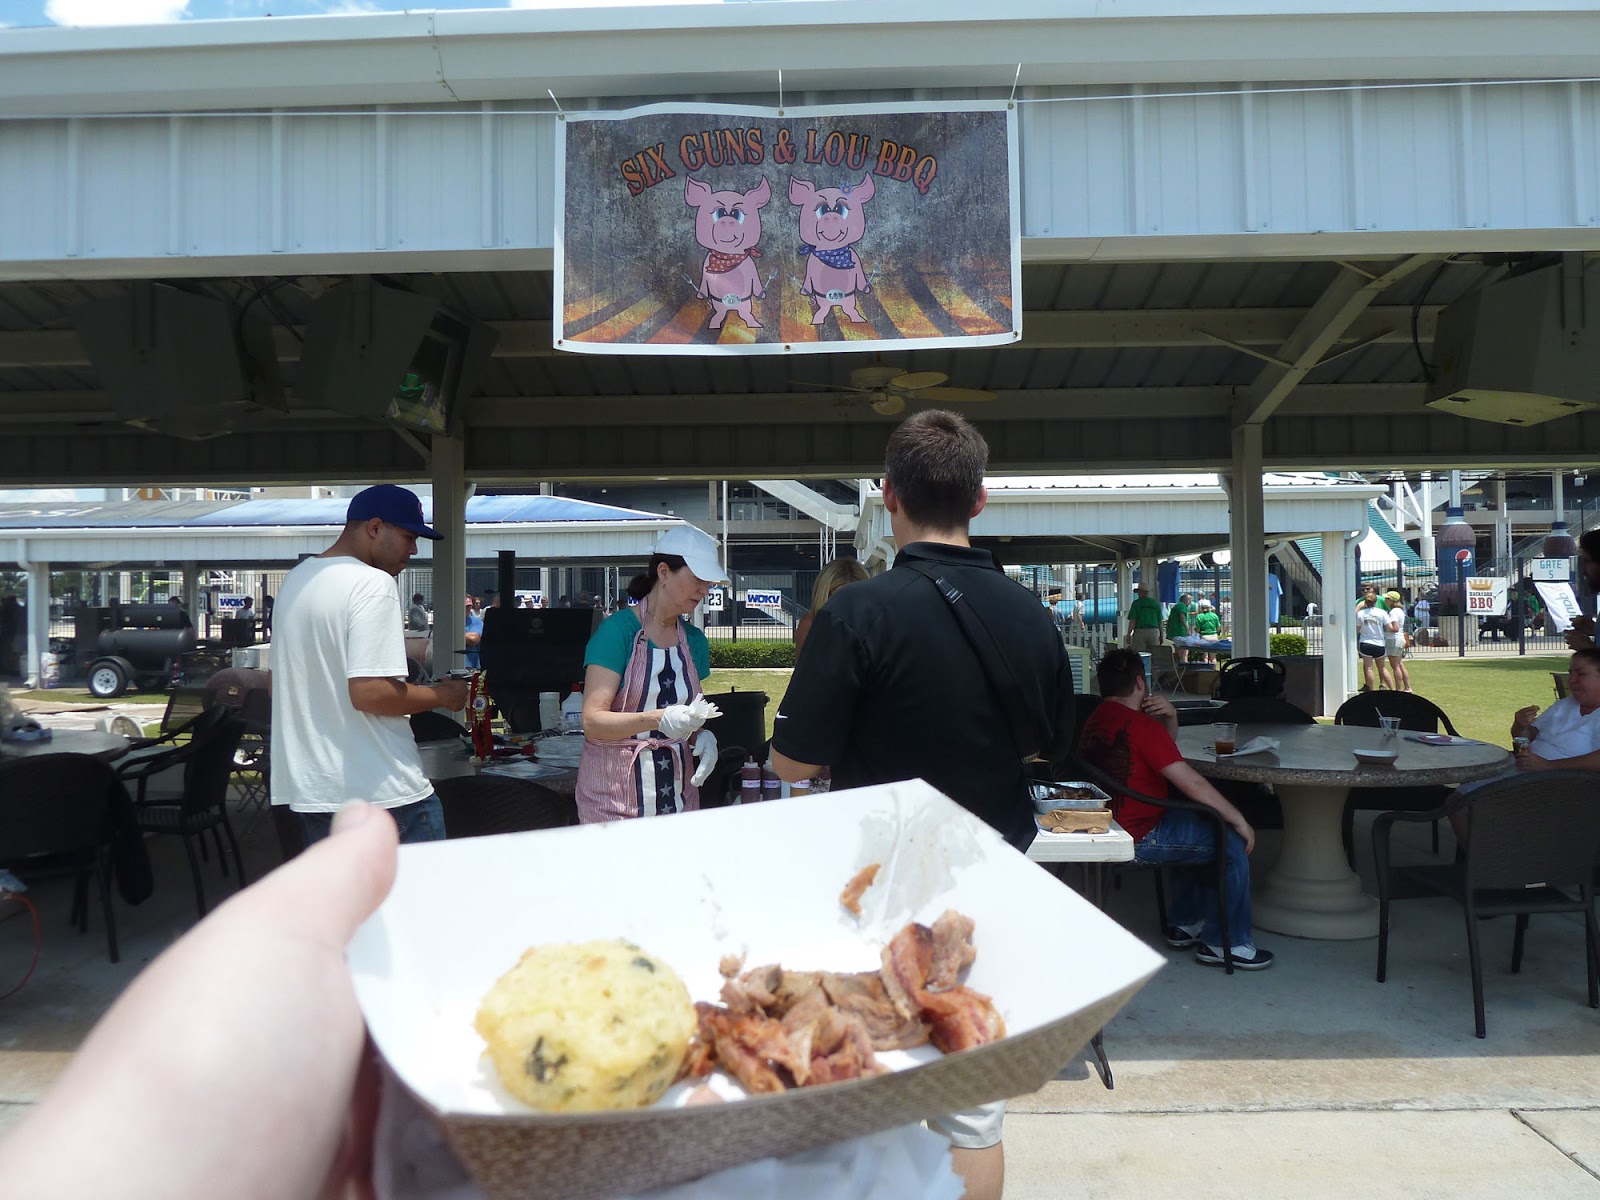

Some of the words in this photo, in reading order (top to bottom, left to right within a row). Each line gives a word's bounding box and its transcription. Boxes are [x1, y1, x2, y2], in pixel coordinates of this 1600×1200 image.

[620, 142, 676, 197] SIX
[680, 127, 765, 171] GUNS
[773, 128, 797, 164] &
[804, 128, 871, 170] LOU
[873, 139, 938, 195] BBQ
[1540, 560, 1562, 569] GATE
[1548, 570, 1554, 578] 5
[219, 598, 245, 607] WOK
[708, 593, 722, 606] 23
[1469, 597, 1493, 609] BBQ
